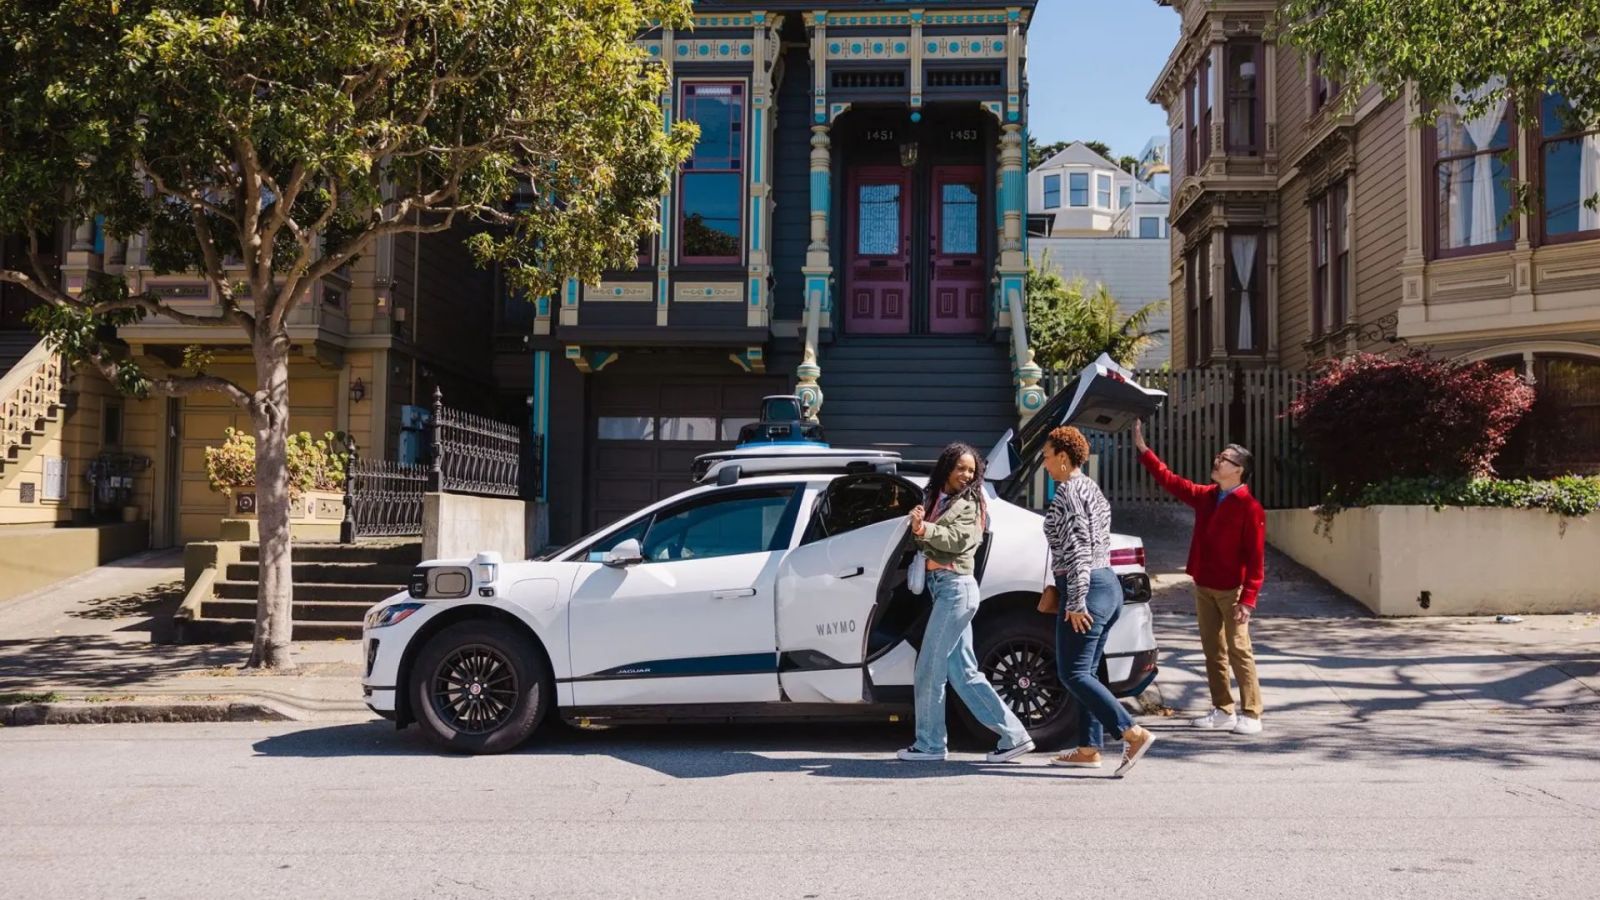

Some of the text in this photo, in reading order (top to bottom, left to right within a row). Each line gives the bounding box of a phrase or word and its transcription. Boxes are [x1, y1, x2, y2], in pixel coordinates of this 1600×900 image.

[867, 130, 893, 140] 1451
[950, 130, 977, 140] 1453
[816, 619, 856, 636] WAYMO
